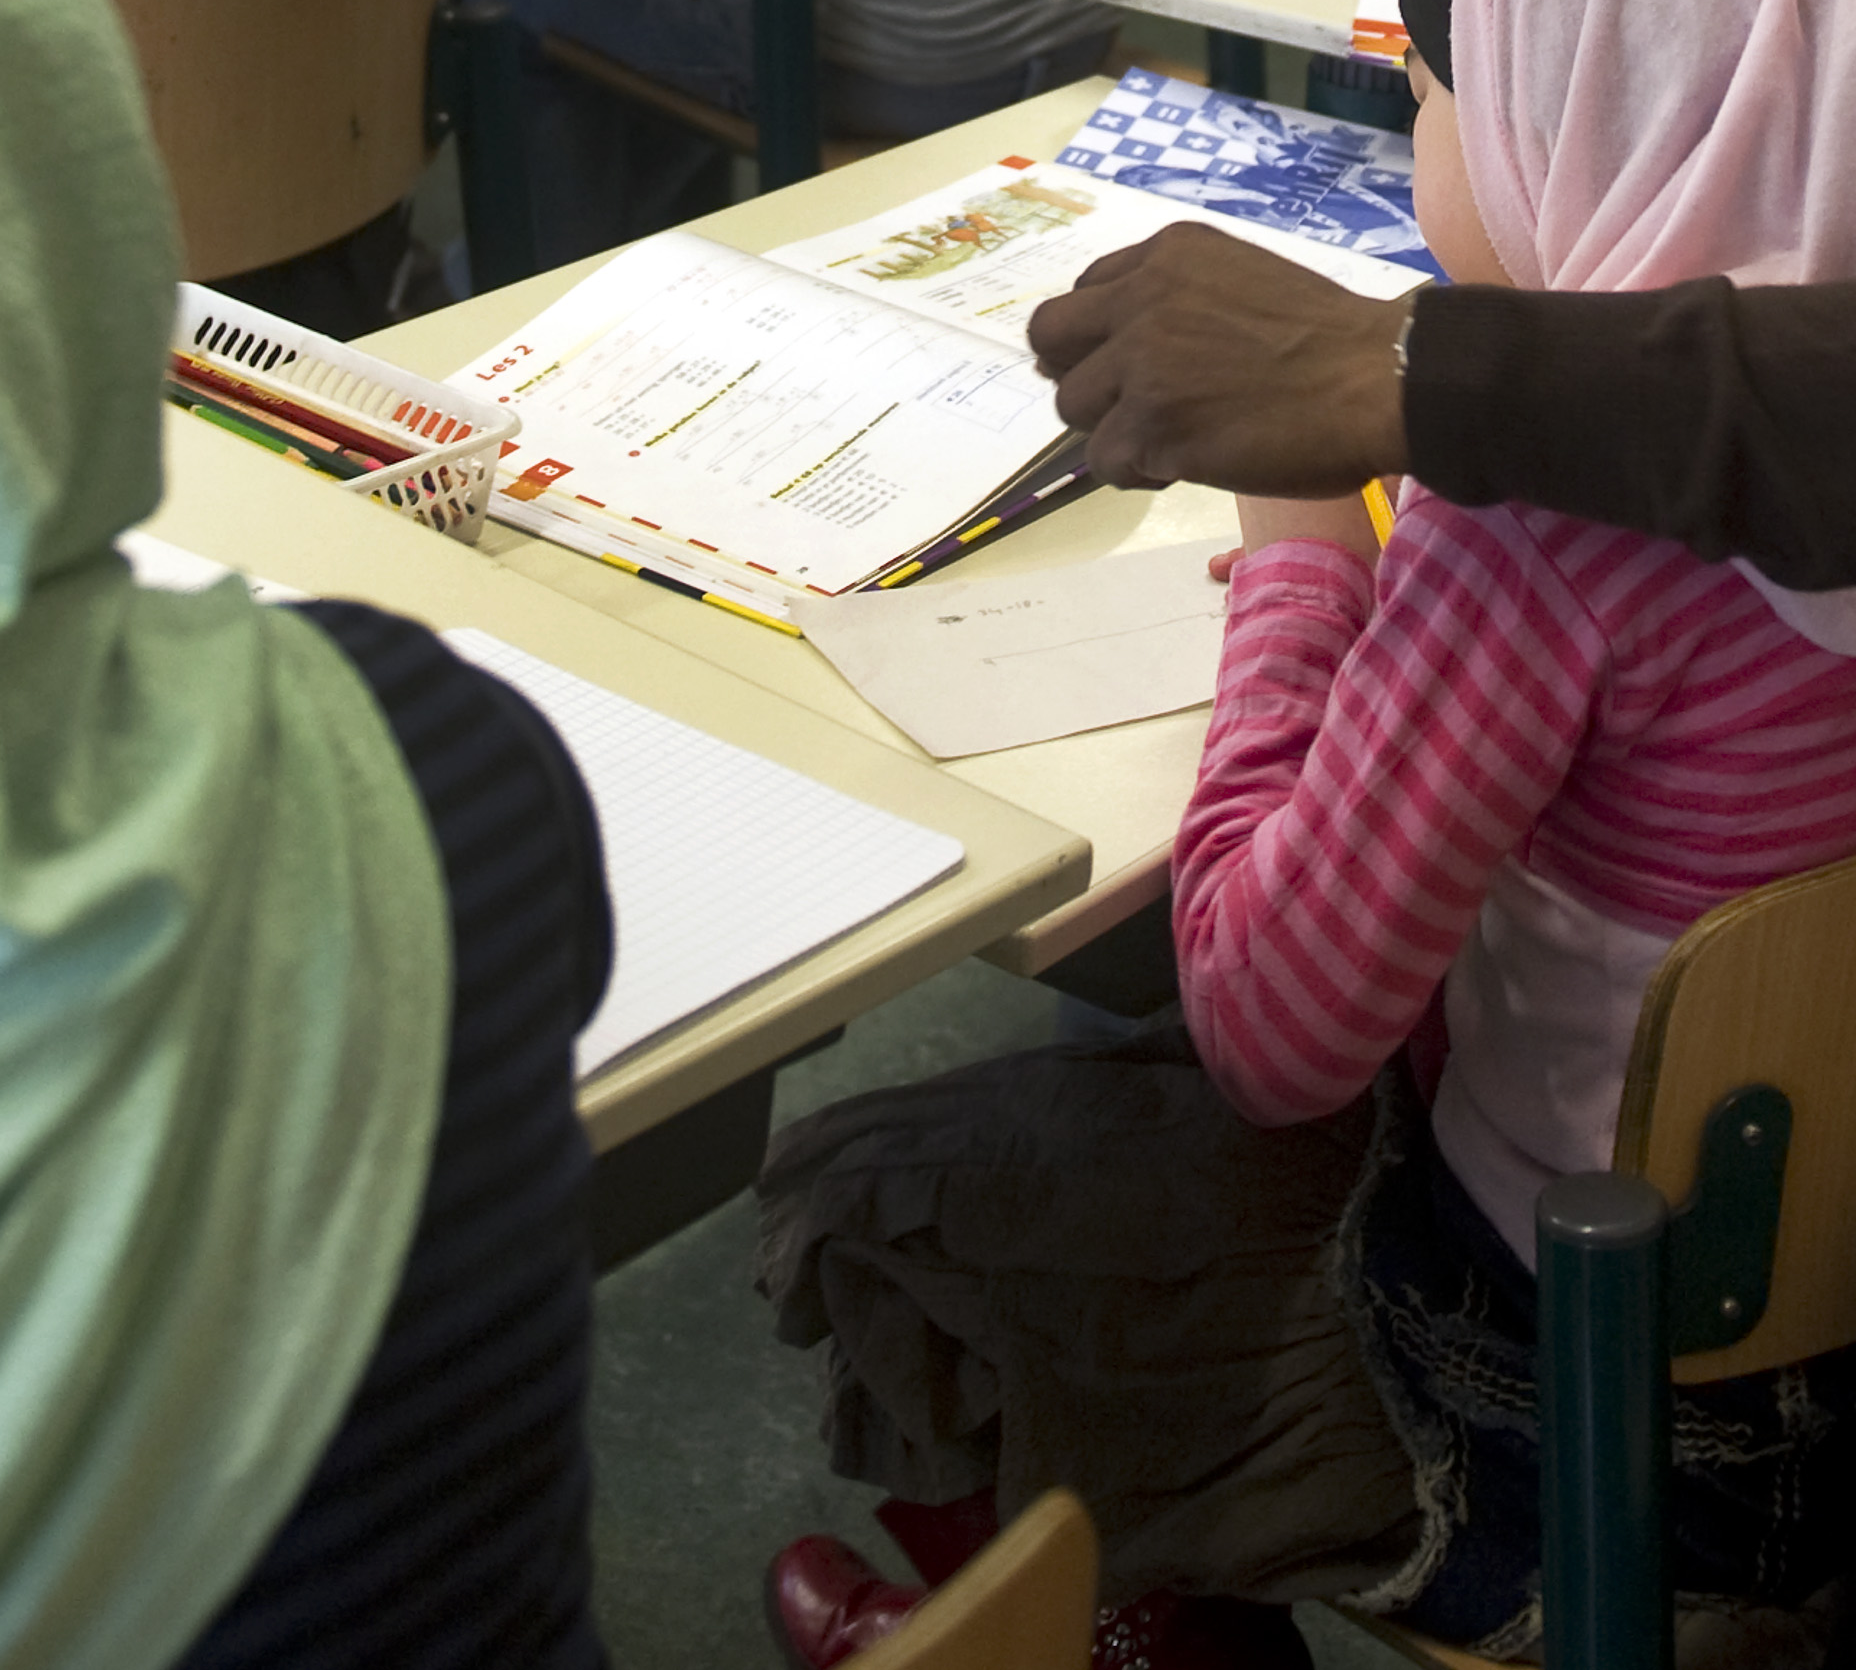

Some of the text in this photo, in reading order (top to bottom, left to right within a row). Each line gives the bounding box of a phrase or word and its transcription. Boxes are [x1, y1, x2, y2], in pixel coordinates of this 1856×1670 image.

[475, 344, 534, 381] Les 2
[538, 464, 560, 477] 8
